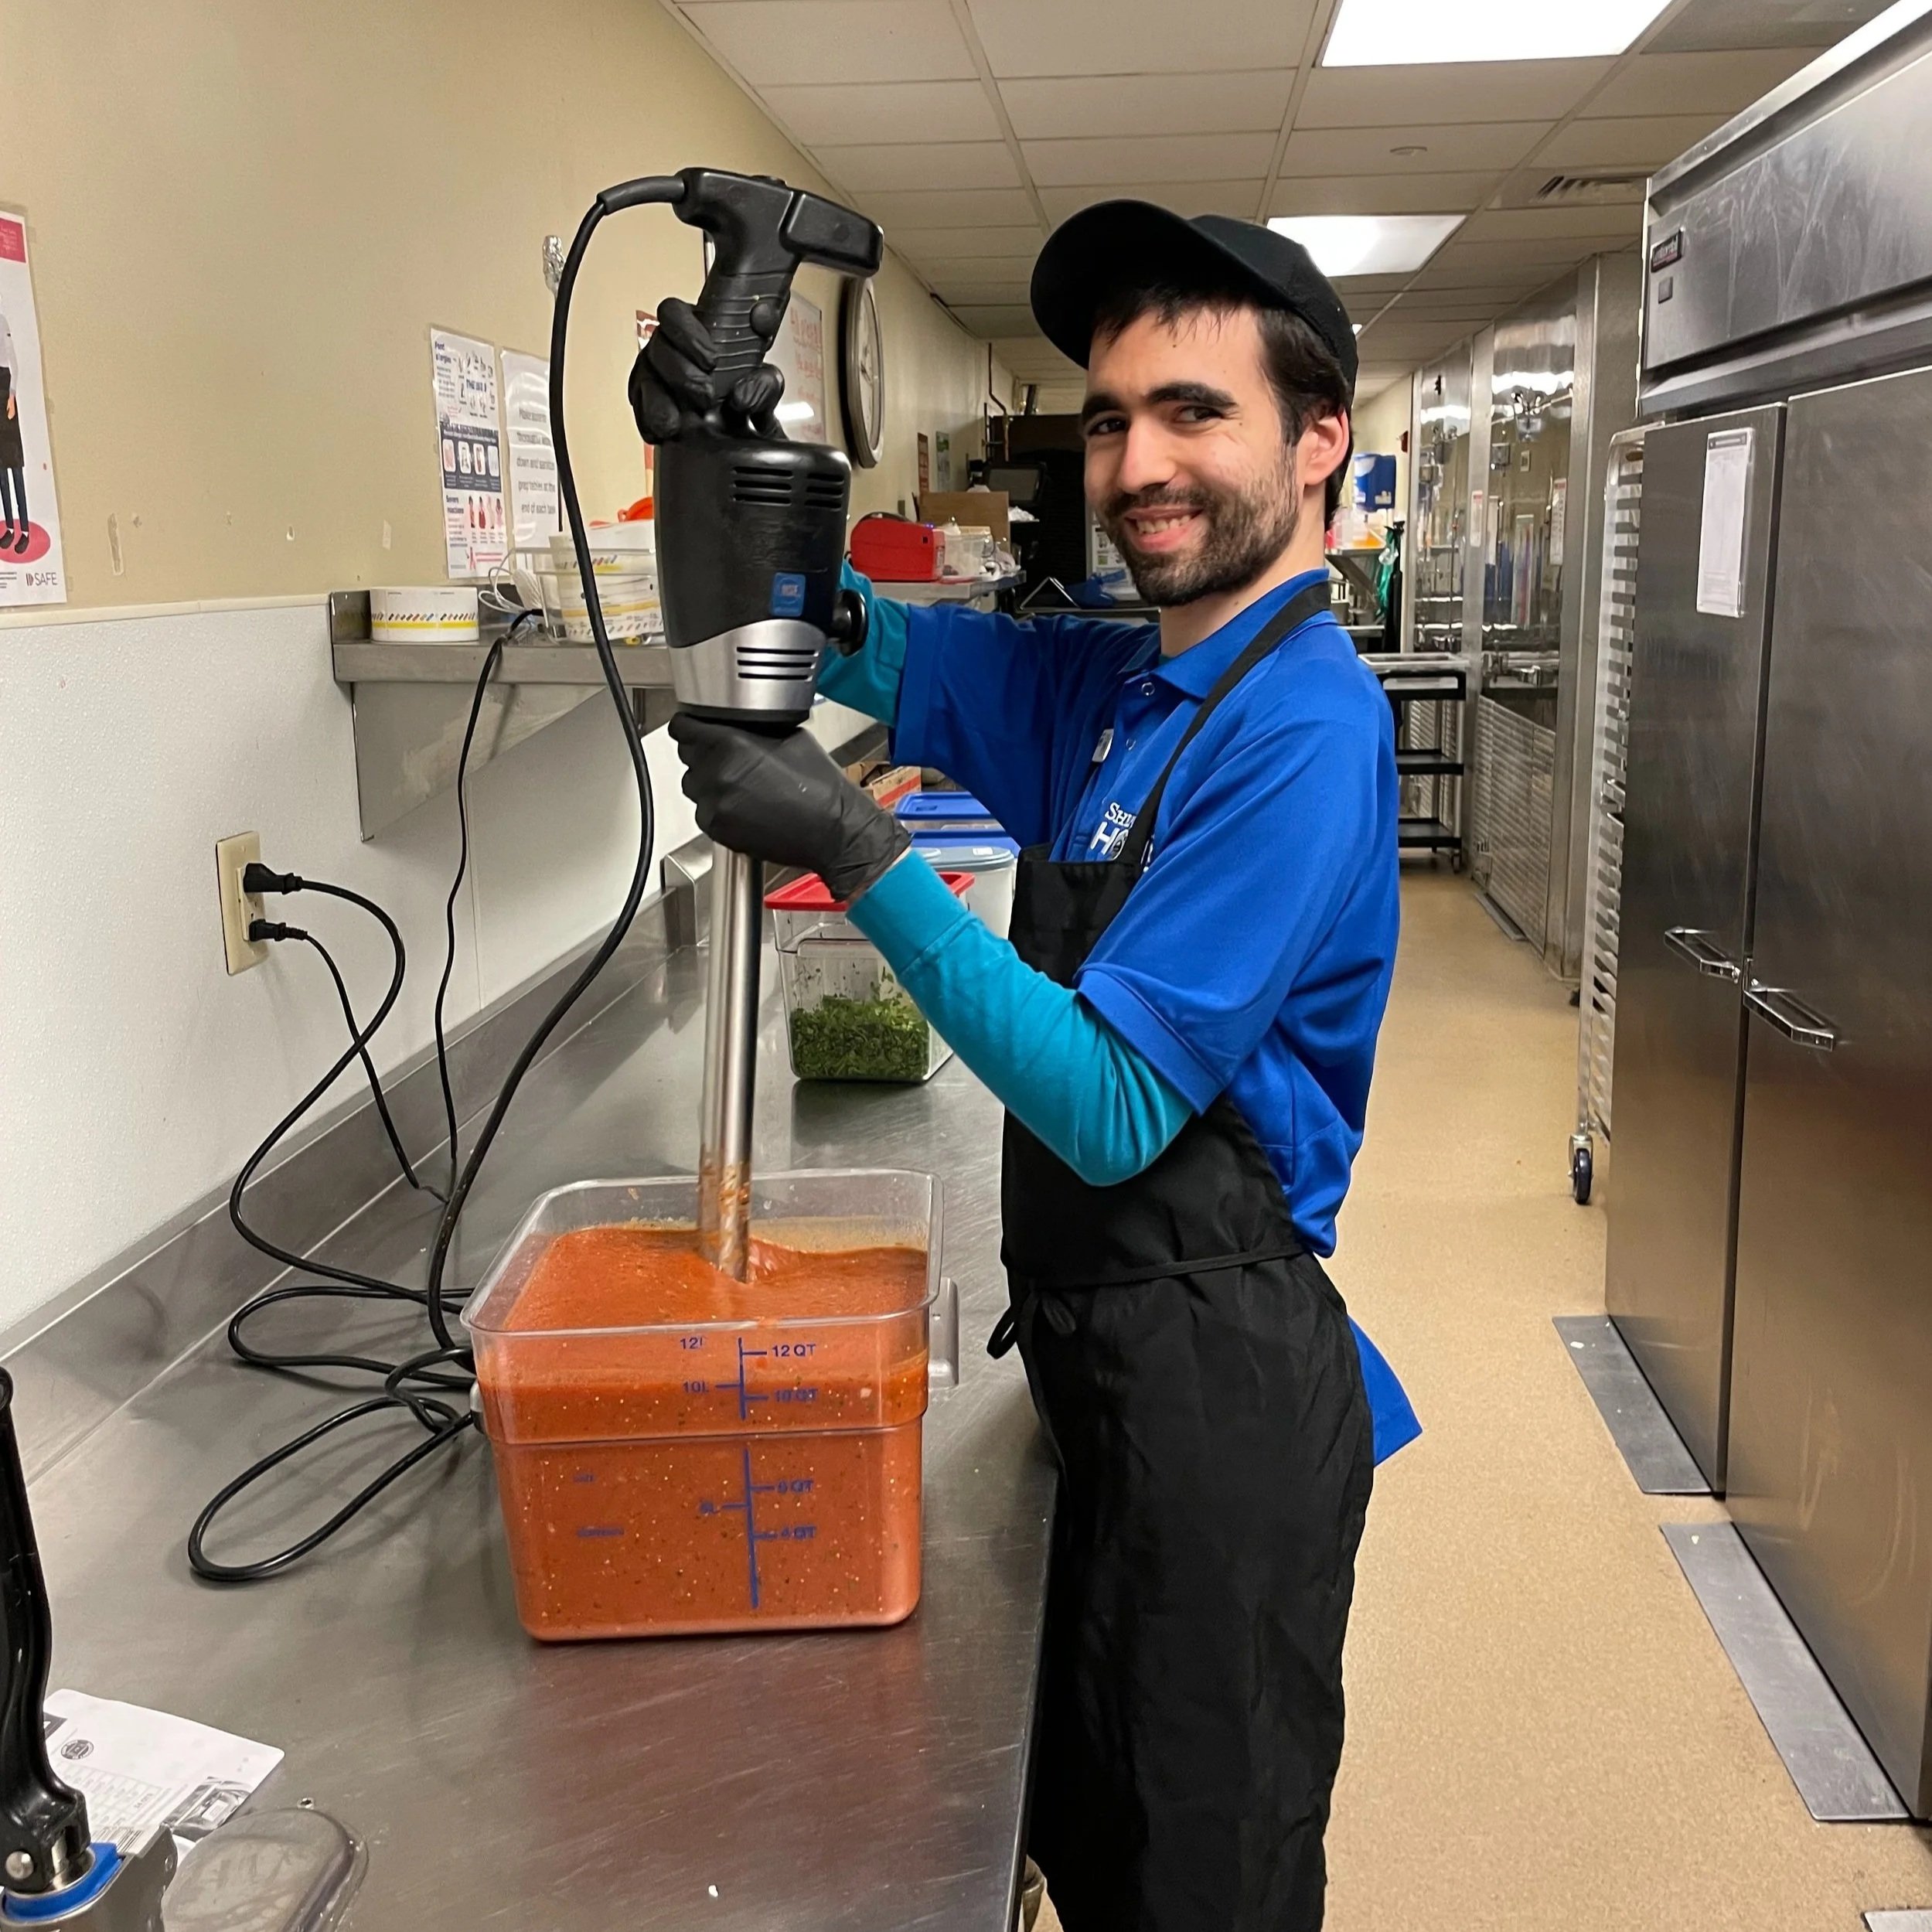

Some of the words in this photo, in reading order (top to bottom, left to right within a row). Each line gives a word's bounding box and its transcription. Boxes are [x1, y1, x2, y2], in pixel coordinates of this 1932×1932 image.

[521, 503, 530, 513] end
[536, 503, 547, 513] each
[772, 1344, 790, 1357] 12
[793, 1344, 816, 1357] QT
[796, 1389, 819, 1402] QT
